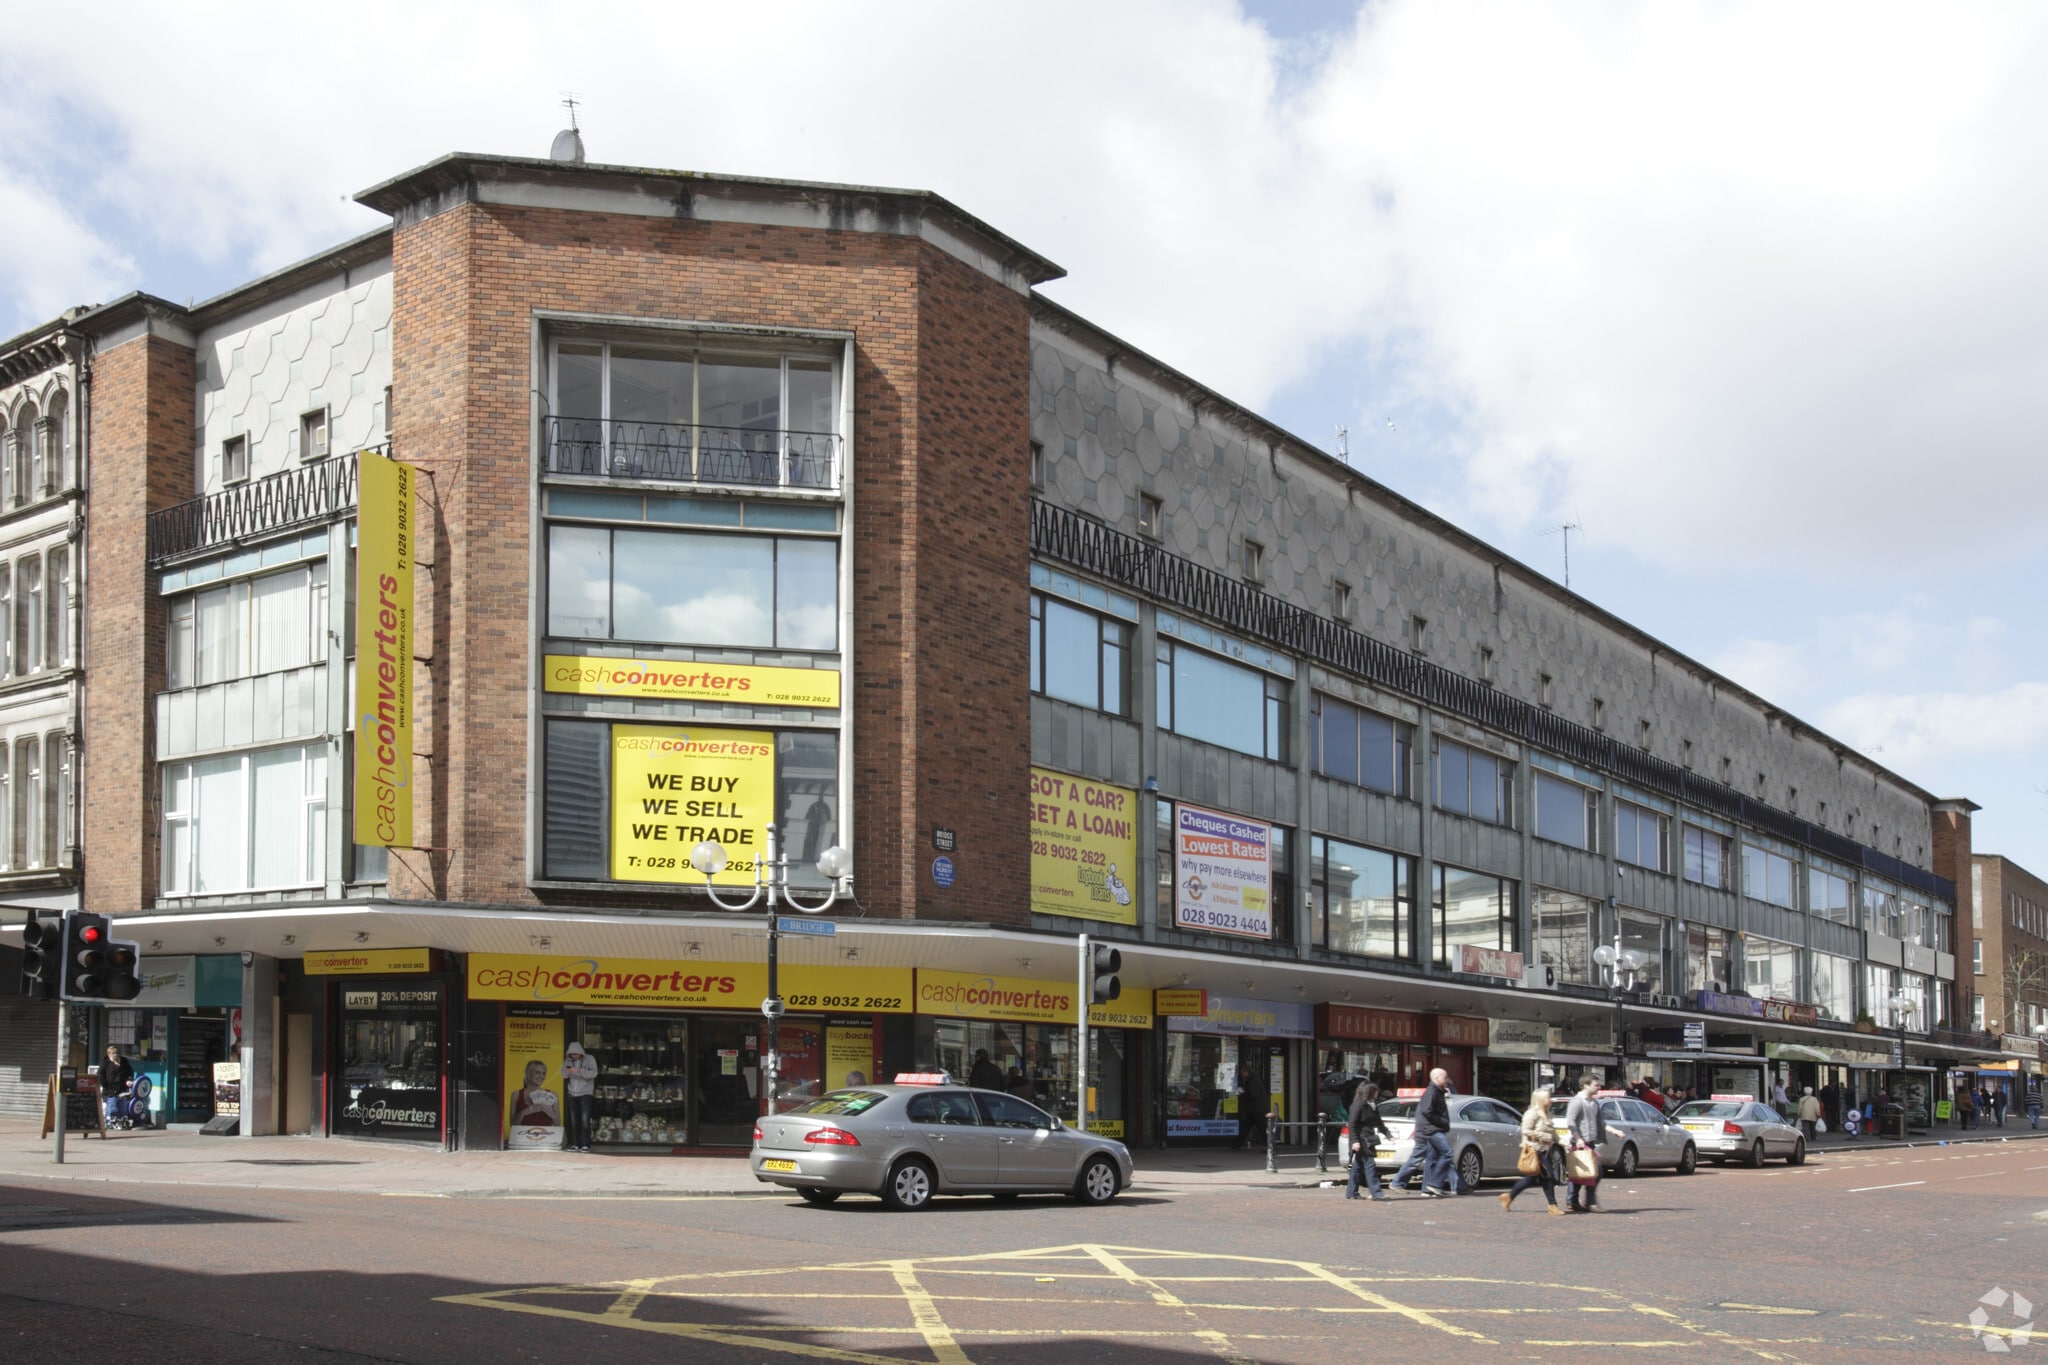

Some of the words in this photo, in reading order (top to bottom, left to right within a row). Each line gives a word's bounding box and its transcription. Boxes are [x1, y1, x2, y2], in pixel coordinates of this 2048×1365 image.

[398, 467, 408, 497] 2622
[398, 500, 407, 530] 9032
[398, 534, 407, 556] 028
[554, 666, 751, 691] cashconverters
[641, 688, 730, 698] www.cashconverters.co.uk
[372, 573, 398, 843] cashconverters
[616, 737, 770, 756] cashconverters
[647, 773, 683, 790] WE
[691, 775, 739, 793] BUY
[1030, 773, 1064, 798] GOT
[1068, 783, 1080, 803] A
[1084, 786, 1124, 812] CAR?
[642, 798, 678, 816] WE
[685, 801, 743, 819] SELL
[632, 823, 668, 840] WE
[675, 825, 754, 845] TRADE
[1066, 810, 1077, 829] A
[1083, 813, 1131, 840] LOAN!
[1181, 812, 1227, 834] Cheques
[1229, 823, 1266, 842] Cashed
[1051, 843, 1078, 861] 9032
[1081, 850, 1106, 866] 2622
[1182, 837, 1229, 855] Lowest
[1232, 841, 1266, 859] Rates
[628, 856, 642, 867] T:
[647, 857, 676, 869] 028
[1182, 859, 1197, 872] why
[1200, 862, 1212, 875] pay
[1214, 865, 1232, 878] more
[1233, 867, 1267, 884] elsewhere
[790, 920, 825, 932] BRIDGE
[1183, 908, 1205, 923] 028
[1208, 911, 1237, 928] 9023
[1240, 917, 1267, 932] 4404
[306, 956, 369, 968] cashconverters
[477, 966, 736, 994] cashconverters
[349, 996, 375, 1006] LAYBY
[381, 991, 399, 1002] 20%
[400, 991, 438, 1002] DEPOSIT
[590, 993, 707, 1002] www.cashconverters.co.uk
[789, 994, 817, 1006] 028
[822, 995, 859, 1007] 9032
[864, 998, 902, 1009] 2622
[921, 982, 1069, 1011] cashconverters
[989, 1009, 1054, 1018] www.cashconverters.co.uk
[1092, 1012, 1106, 1022] 028
[1108, 1013, 1126, 1023] 9032
[1129, 1014, 1148, 1024] 2622
[510, 1021, 547, 1030] instant
[1217, 1023, 1241, 1032] Financial
[1242, 1025, 1264, 1033] Services
[1337, 1015, 1417, 1037] restaurant
[343, 1104, 437, 1123] cashconverters
[1175, 1124, 1200, 1132] Services
